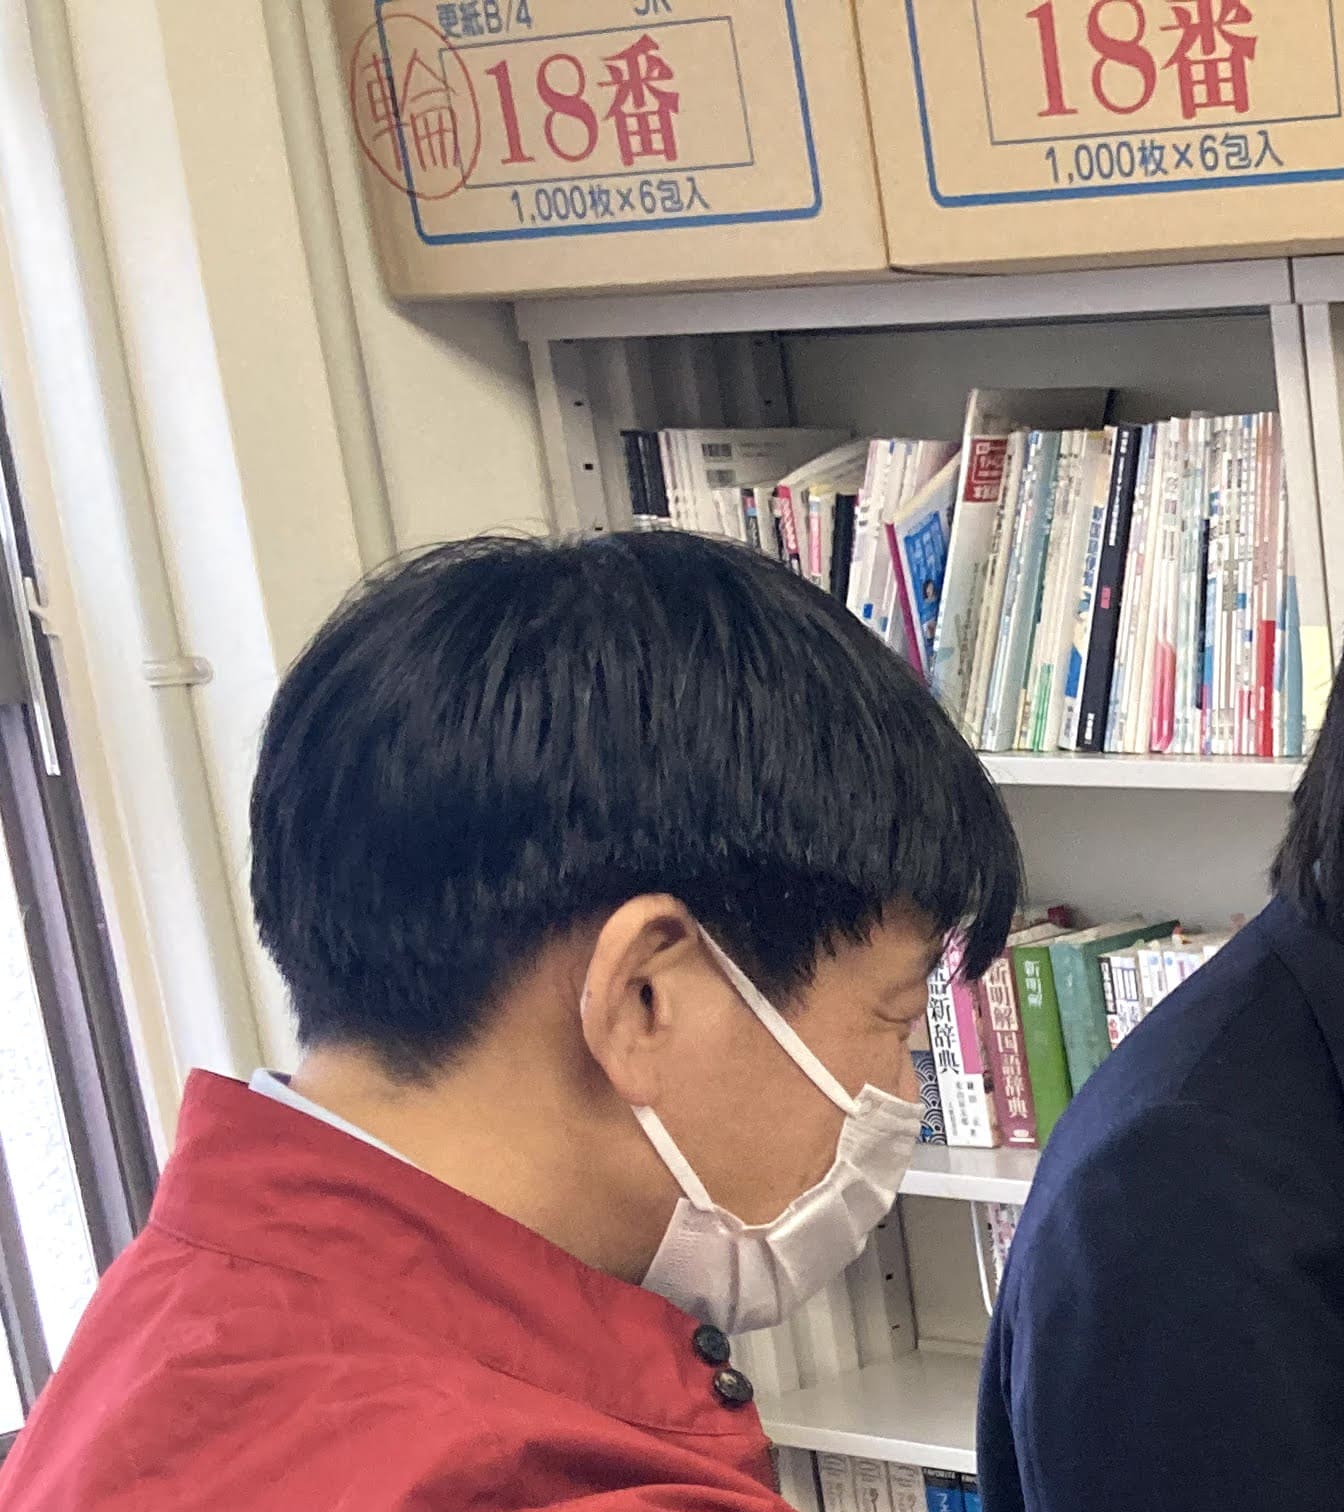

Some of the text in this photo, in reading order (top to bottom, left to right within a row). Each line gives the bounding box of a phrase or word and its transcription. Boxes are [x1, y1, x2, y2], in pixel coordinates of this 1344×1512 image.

[485, 32, 680, 168] 18番
[1025, 0, 1258, 119] 18番
[988, 957, 1029, 1120] 新明解国語辞典
